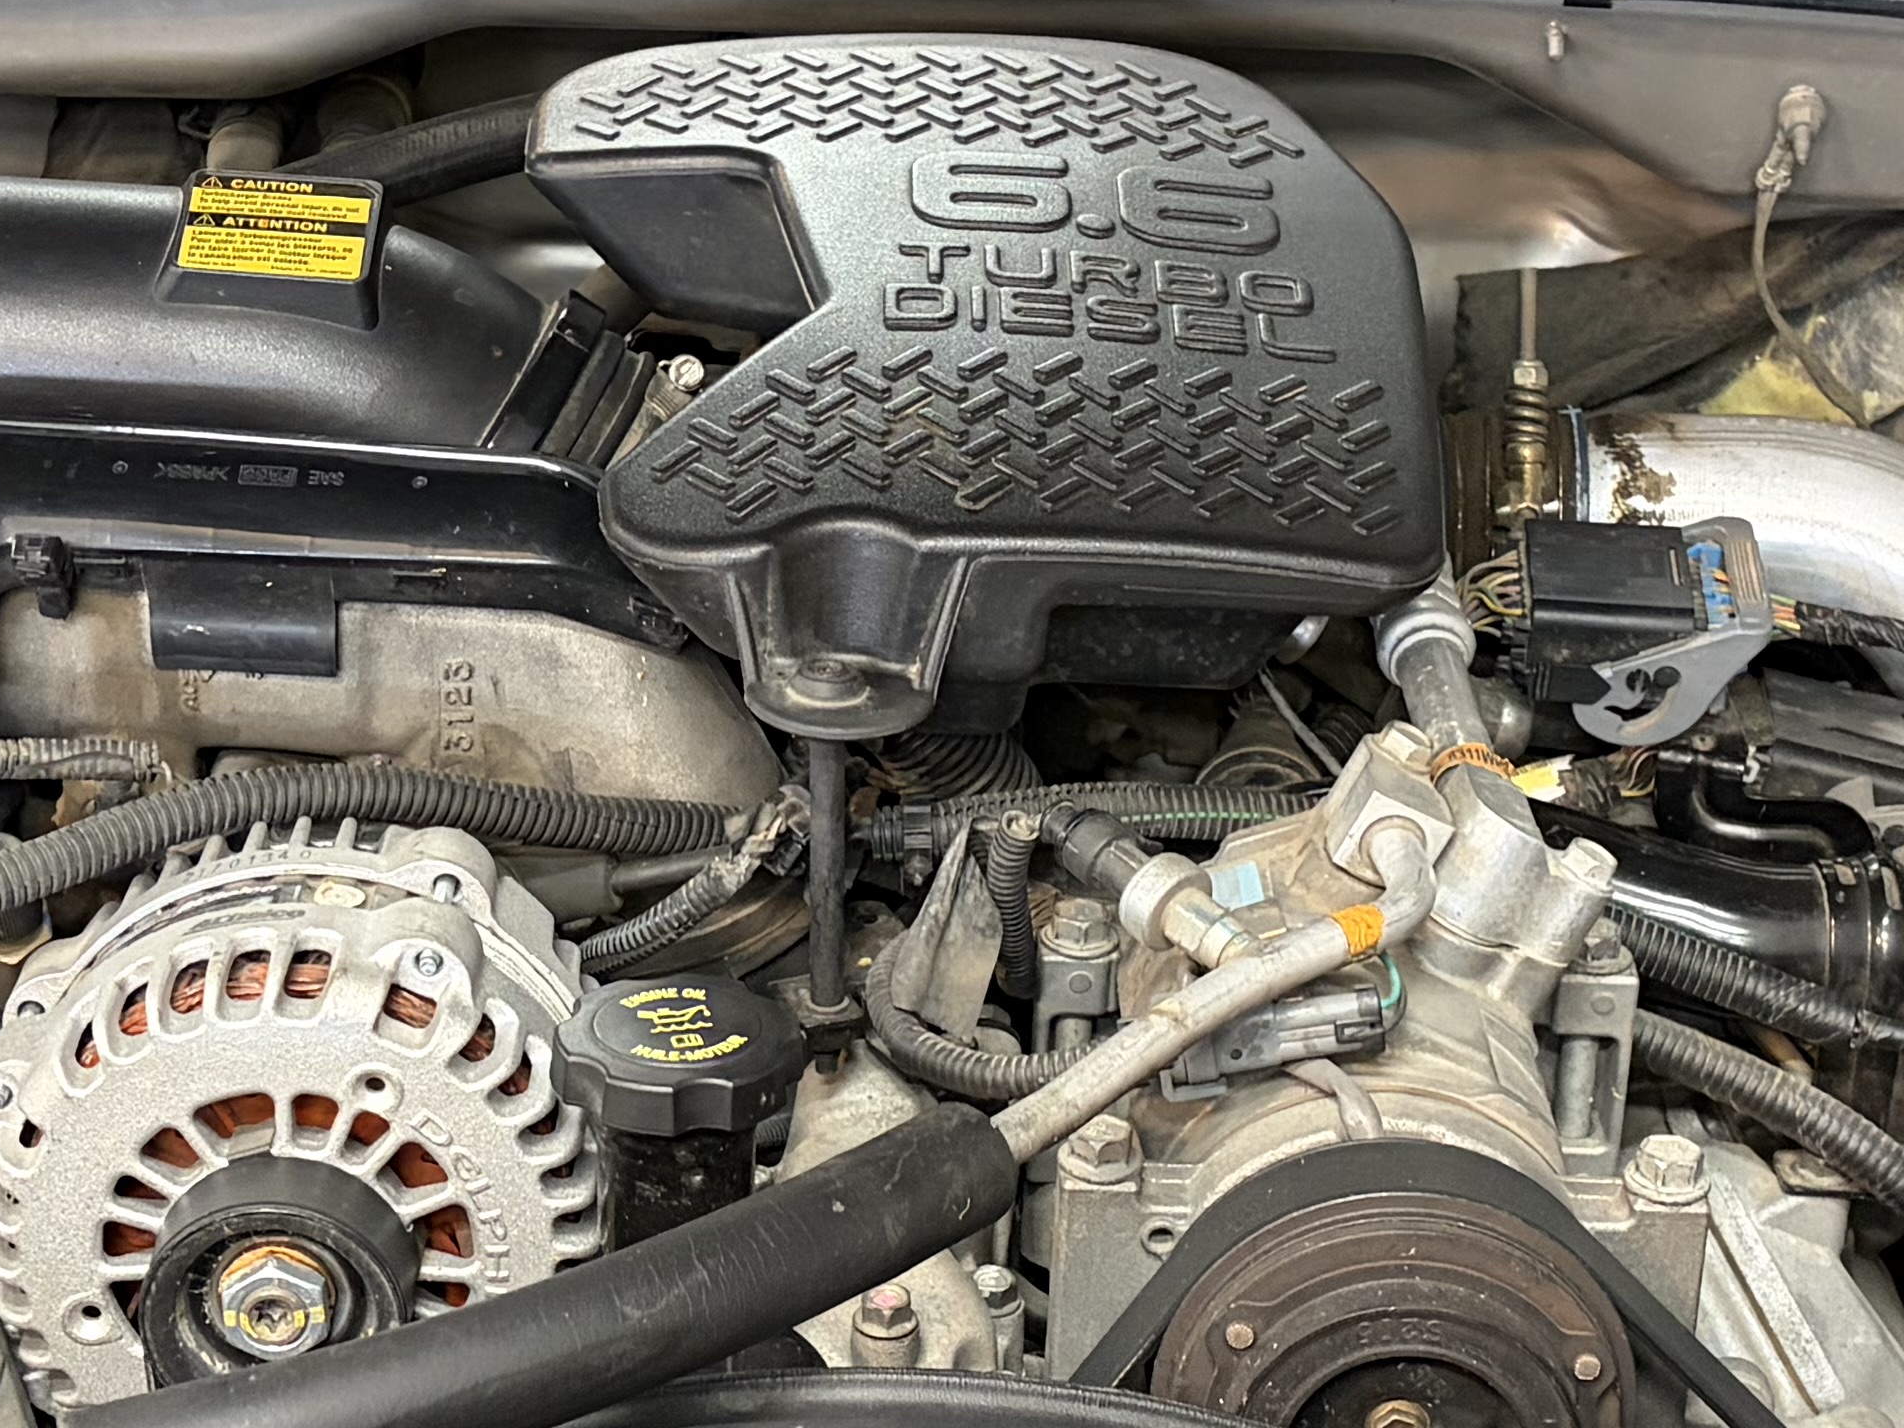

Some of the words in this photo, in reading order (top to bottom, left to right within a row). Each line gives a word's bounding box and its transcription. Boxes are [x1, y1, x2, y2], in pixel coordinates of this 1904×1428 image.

[230, 179, 313, 193] CAUTION
[911, 151, 1280, 255] 6.6
[223, 217, 327, 232] ATTENTION
[899, 242, 1313, 315] TURBO
[884, 282, 1337, 363] DIESEL
[619, 987, 679, 1009] ENGINE
[682, 988, 707, 1001] OIL
[630, 1034, 749, 1062] HUILE-MOTEUR
